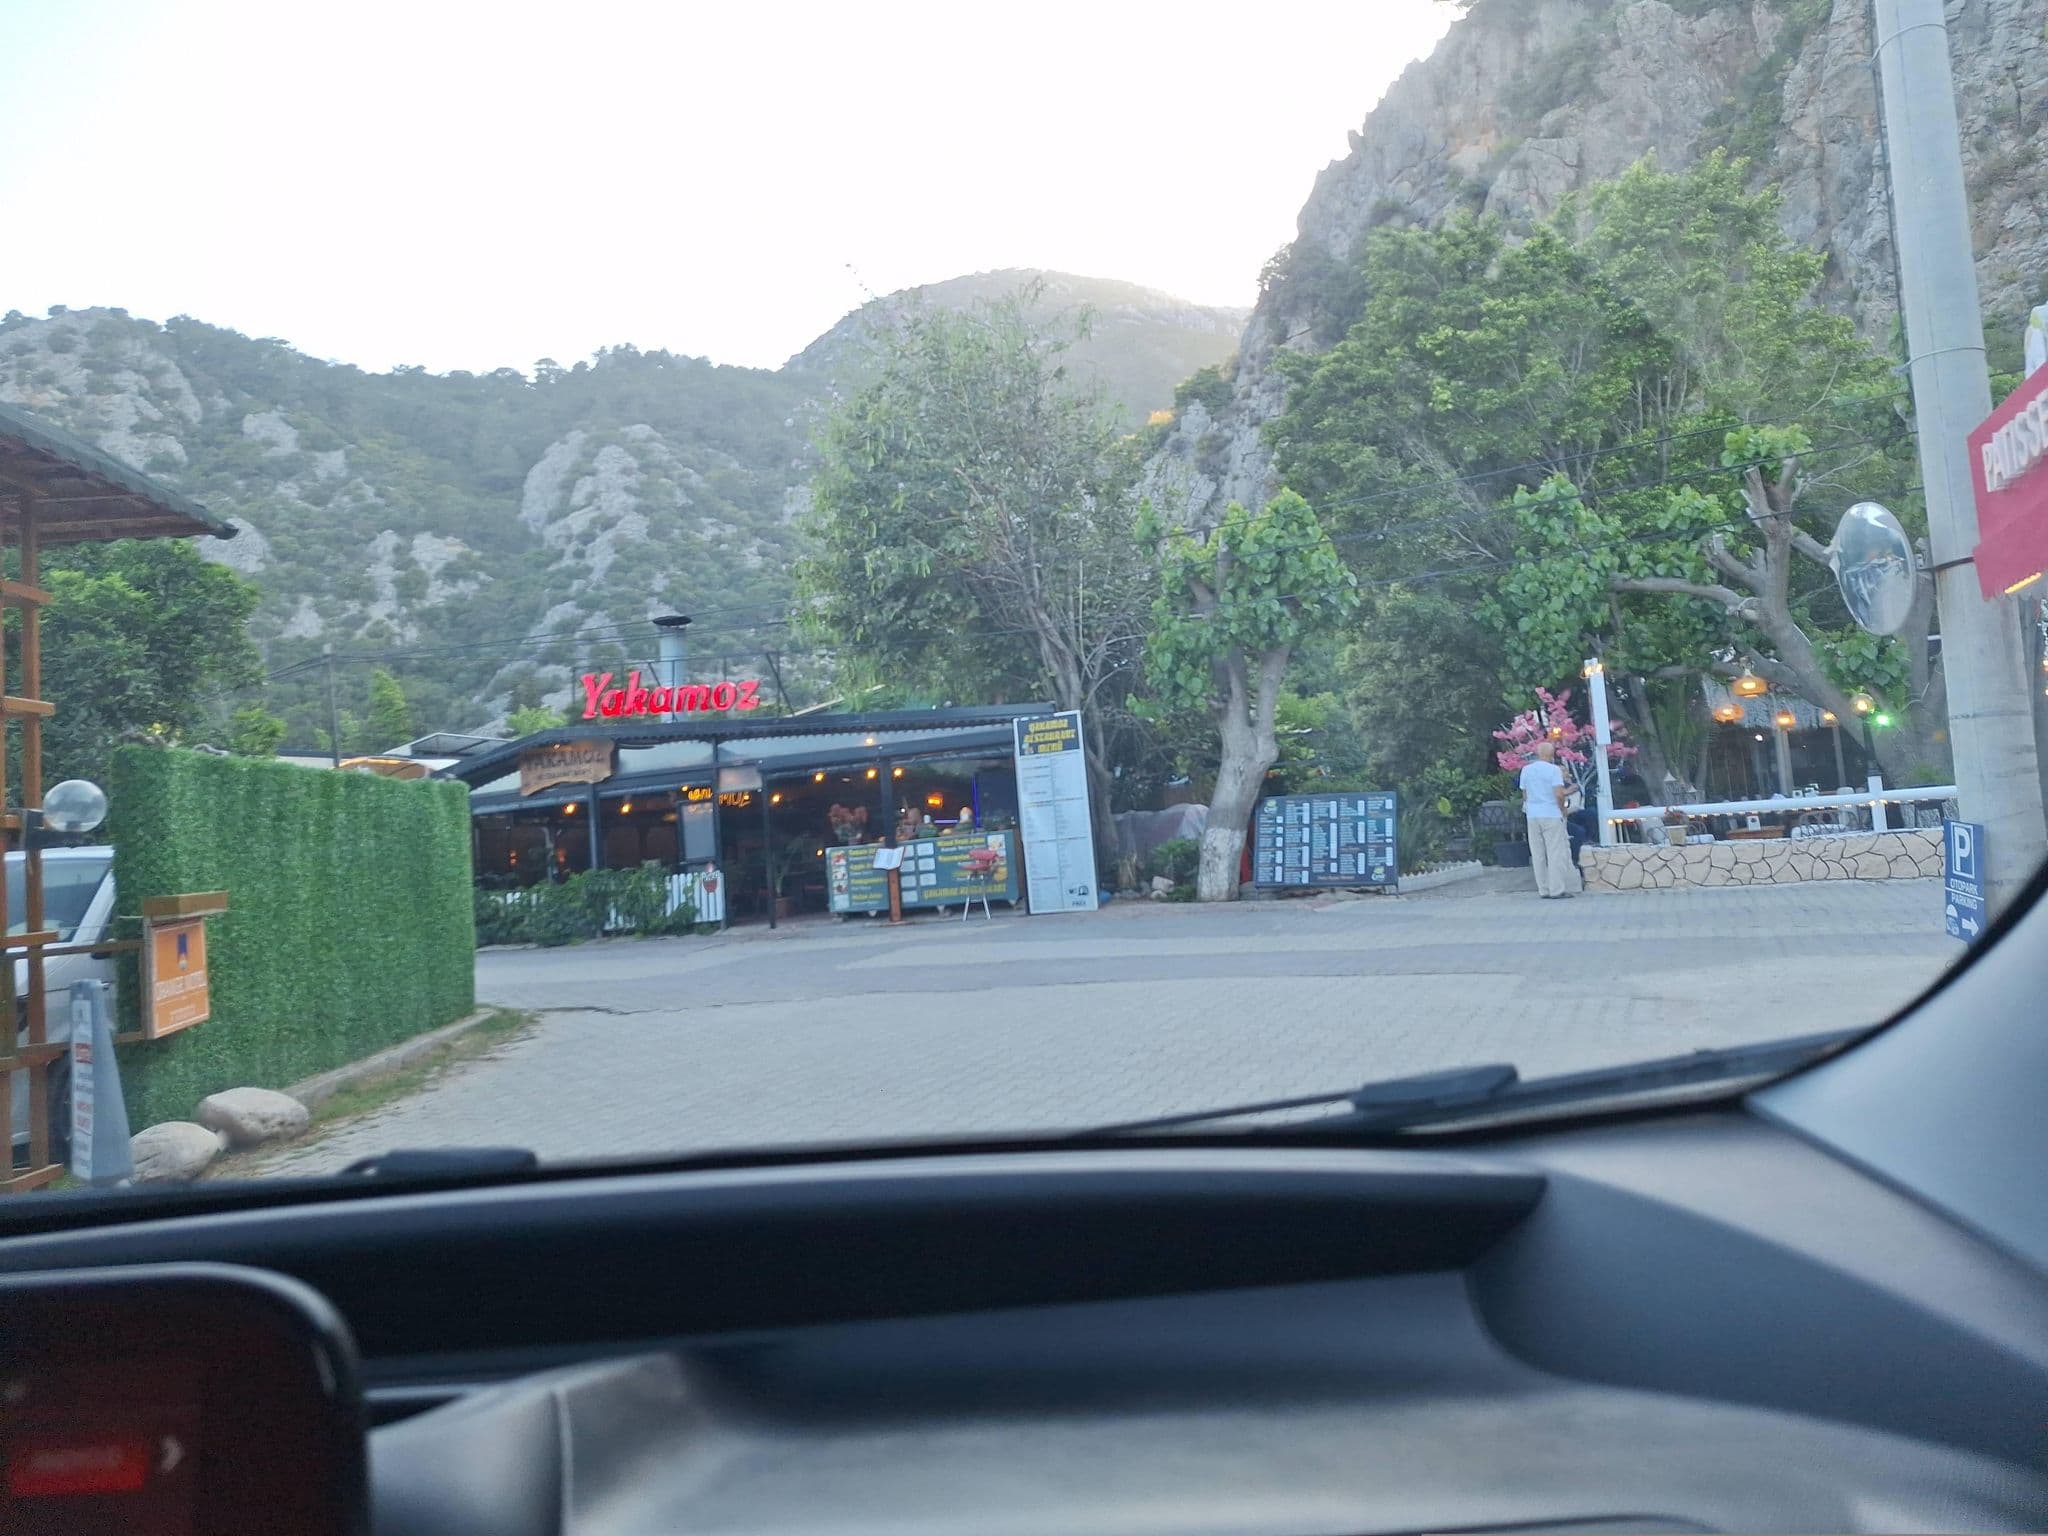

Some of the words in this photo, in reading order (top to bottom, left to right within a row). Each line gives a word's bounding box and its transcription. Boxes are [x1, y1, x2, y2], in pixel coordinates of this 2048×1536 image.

[580, 671, 760, 720] Yakamoz
[1954, 826, 1971, 871] P
[1950, 878, 1978, 896] OTOPARK
[1951, 892, 1977, 910] PARKING
